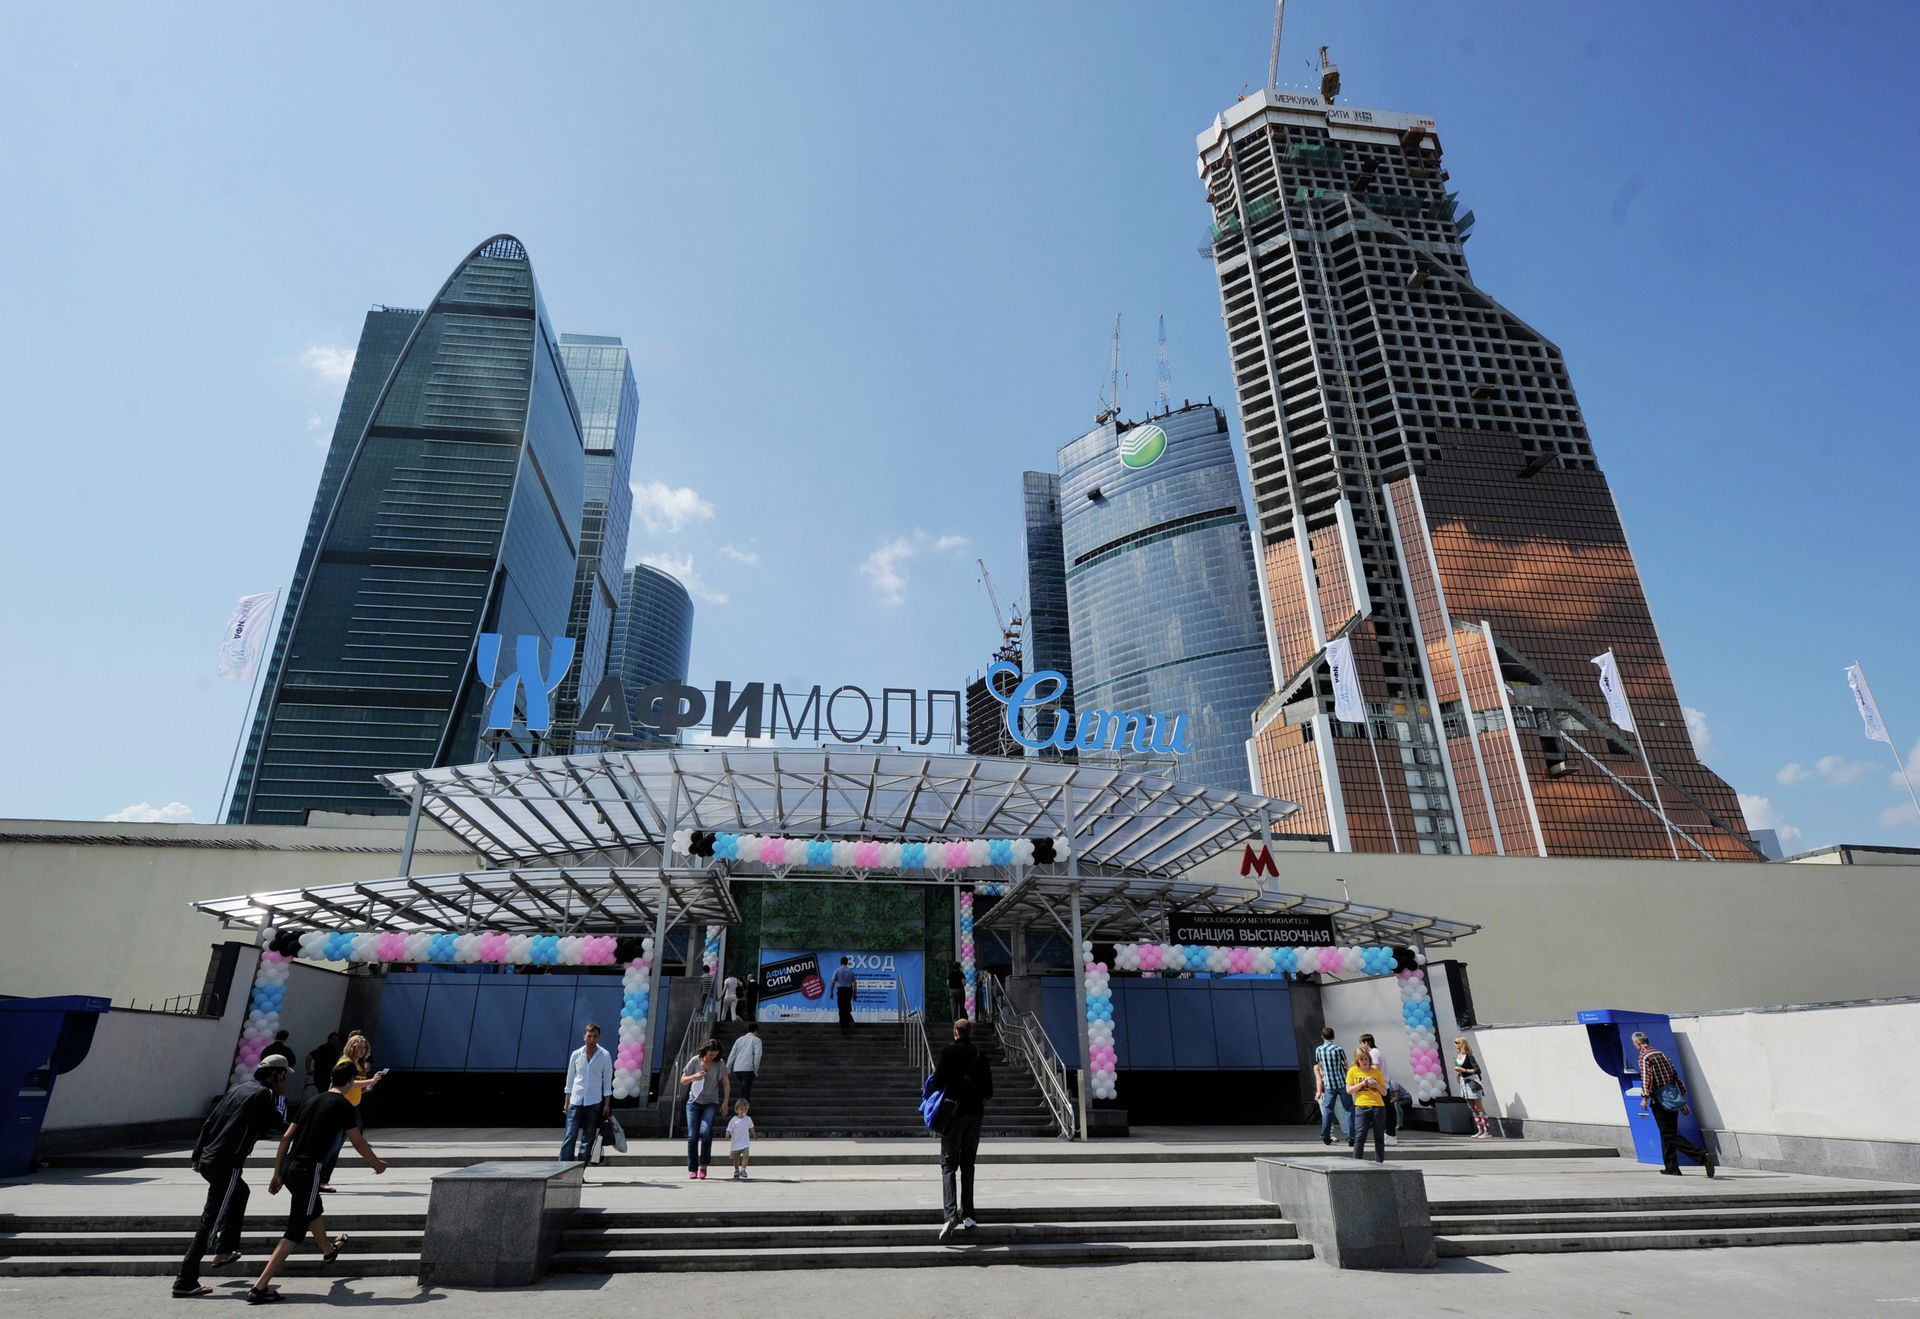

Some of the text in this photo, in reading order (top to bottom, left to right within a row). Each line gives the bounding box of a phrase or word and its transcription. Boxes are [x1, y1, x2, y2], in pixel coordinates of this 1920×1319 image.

[1274, 94, 1319, 106] МЕРКУРИЙ
[1328, 109, 1350, 119] СИТИ
[575, 661, 1195, 754] АФИМОЛЛ Сити
[1193, 916, 1310, 925] МОСКОВСКИЙ МЕТРОПОЛИТЕН
[1177, 928, 1331, 942] СТАНЦИЯ ВЫСТАВОЧНАЯ
[765, 960, 815, 979] АФИМОЛЛ
[846, 954, 896, 972] ВХОД
[766, 975, 792, 988] СИТИ
